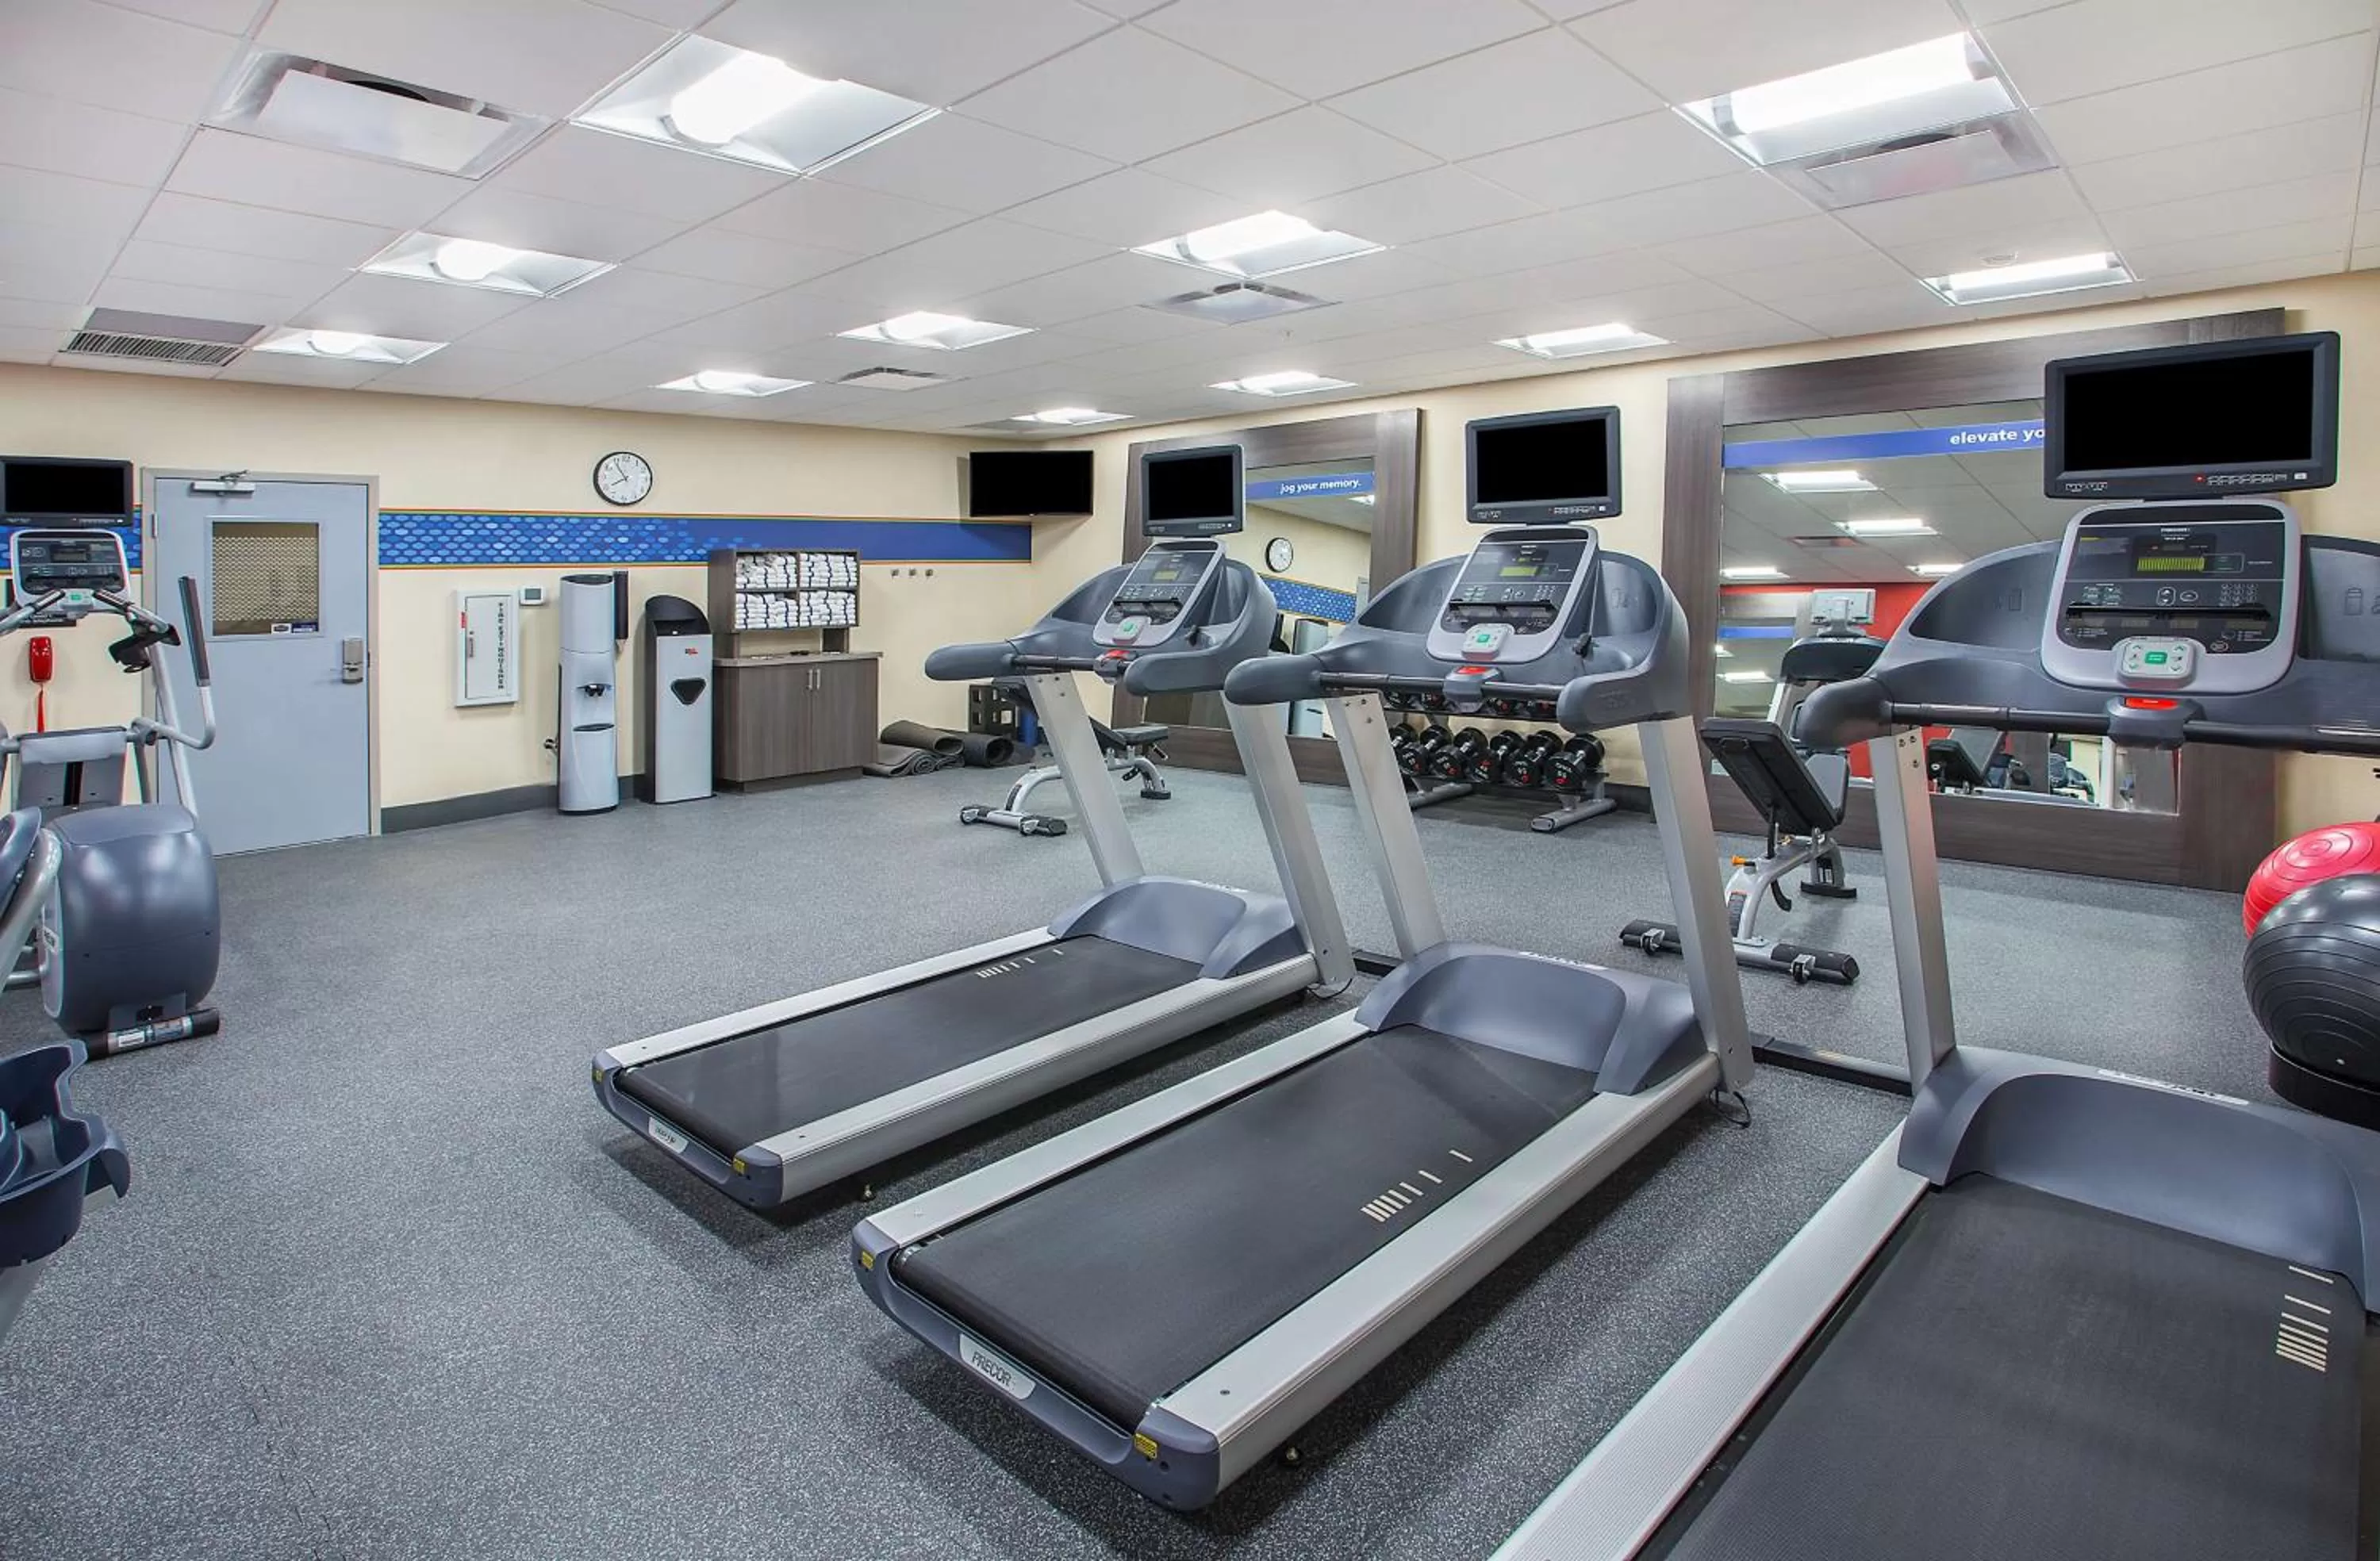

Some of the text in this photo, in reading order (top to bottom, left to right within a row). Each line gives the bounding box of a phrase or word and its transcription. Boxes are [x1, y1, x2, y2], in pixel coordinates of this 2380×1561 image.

[1949, 429, 2017, 445] elevate
[1280, 482, 1295, 495] jog
[1297, 482, 1318, 493] your
[972, 1351, 1012, 1386] PRECOR
